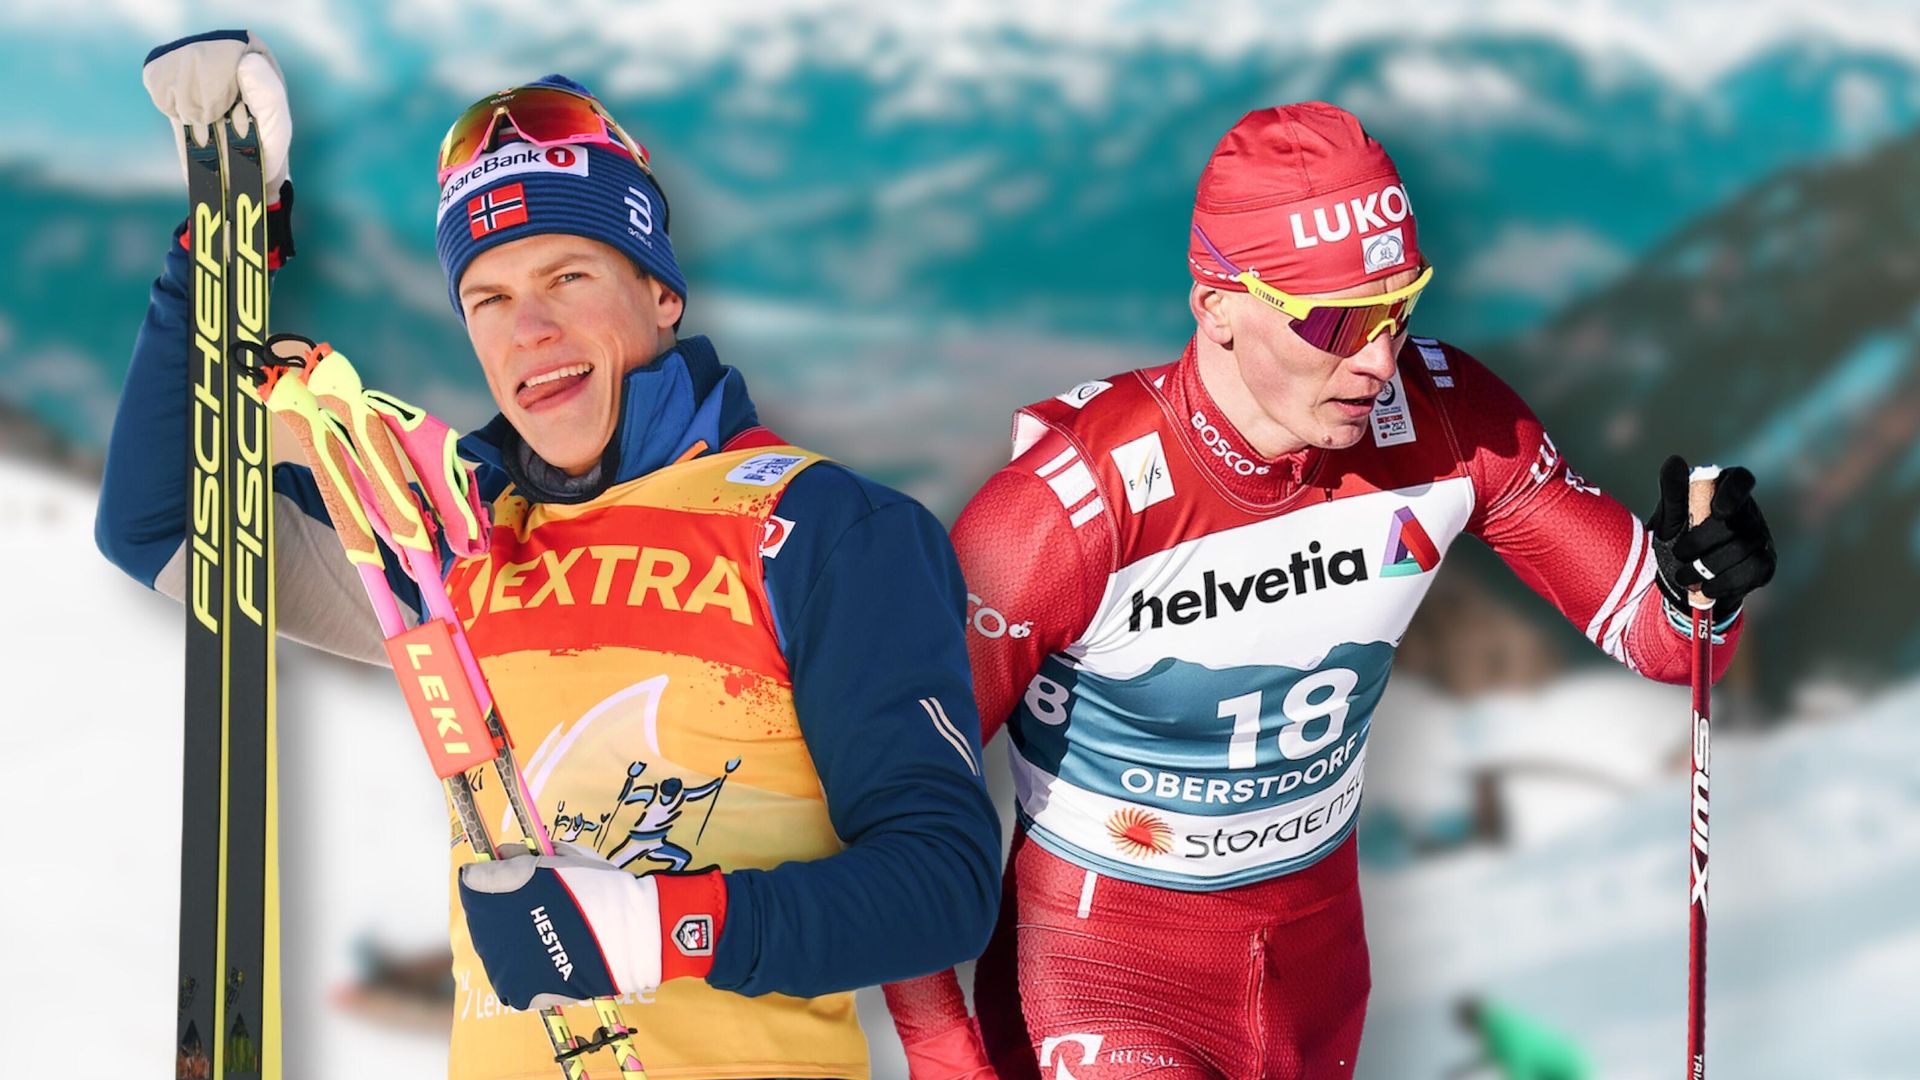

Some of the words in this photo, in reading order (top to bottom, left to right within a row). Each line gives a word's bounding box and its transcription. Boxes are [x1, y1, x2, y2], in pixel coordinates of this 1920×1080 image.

[1289, 183, 1414, 249] LUKO
[193, 202, 221, 634] FISCHER
[237, 193, 263, 626] FISCHER
[1190, 411, 1257, 476] BOSCO
[1128, 540, 1368, 632] helvetia
[406, 643, 471, 754] LEKI
[1216, 668, 1359, 770] 18
[1120, 730, 1358, 804] OBERSTDORF
[1691, 709, 1710, 918] SWIX
[530, 905, 575, 983] HESTRA
[1109, 1049, 1180, 1068] RUSAL
